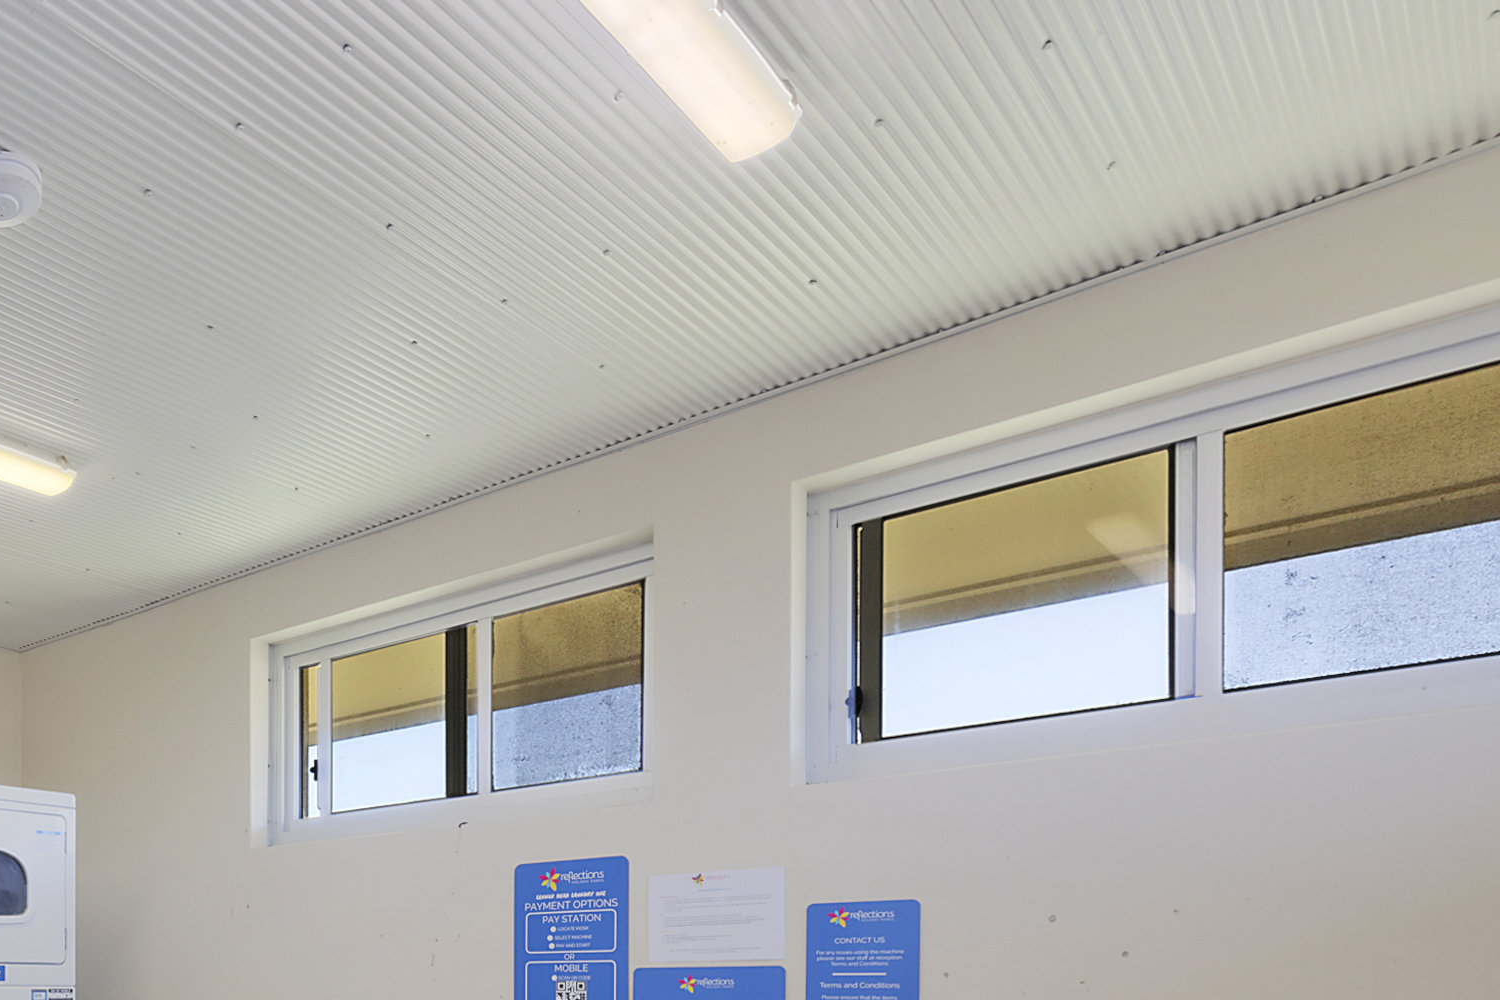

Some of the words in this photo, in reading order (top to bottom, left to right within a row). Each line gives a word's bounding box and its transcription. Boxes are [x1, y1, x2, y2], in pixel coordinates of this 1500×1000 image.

[560, 869, 605, 883] reflections
[524, 900, 571, 911] PAYMENT
[572, 898, 618, 909] OPTIONS
[542, 915, 560, 924] PAY
[562, 914, 601, 923] STATION
[850, 909, 895, 921] reflections
[873, 936, 886, 944] US
[554, 964, 588, 973] MOBILE
[697, 977, 735, 987] reflections
